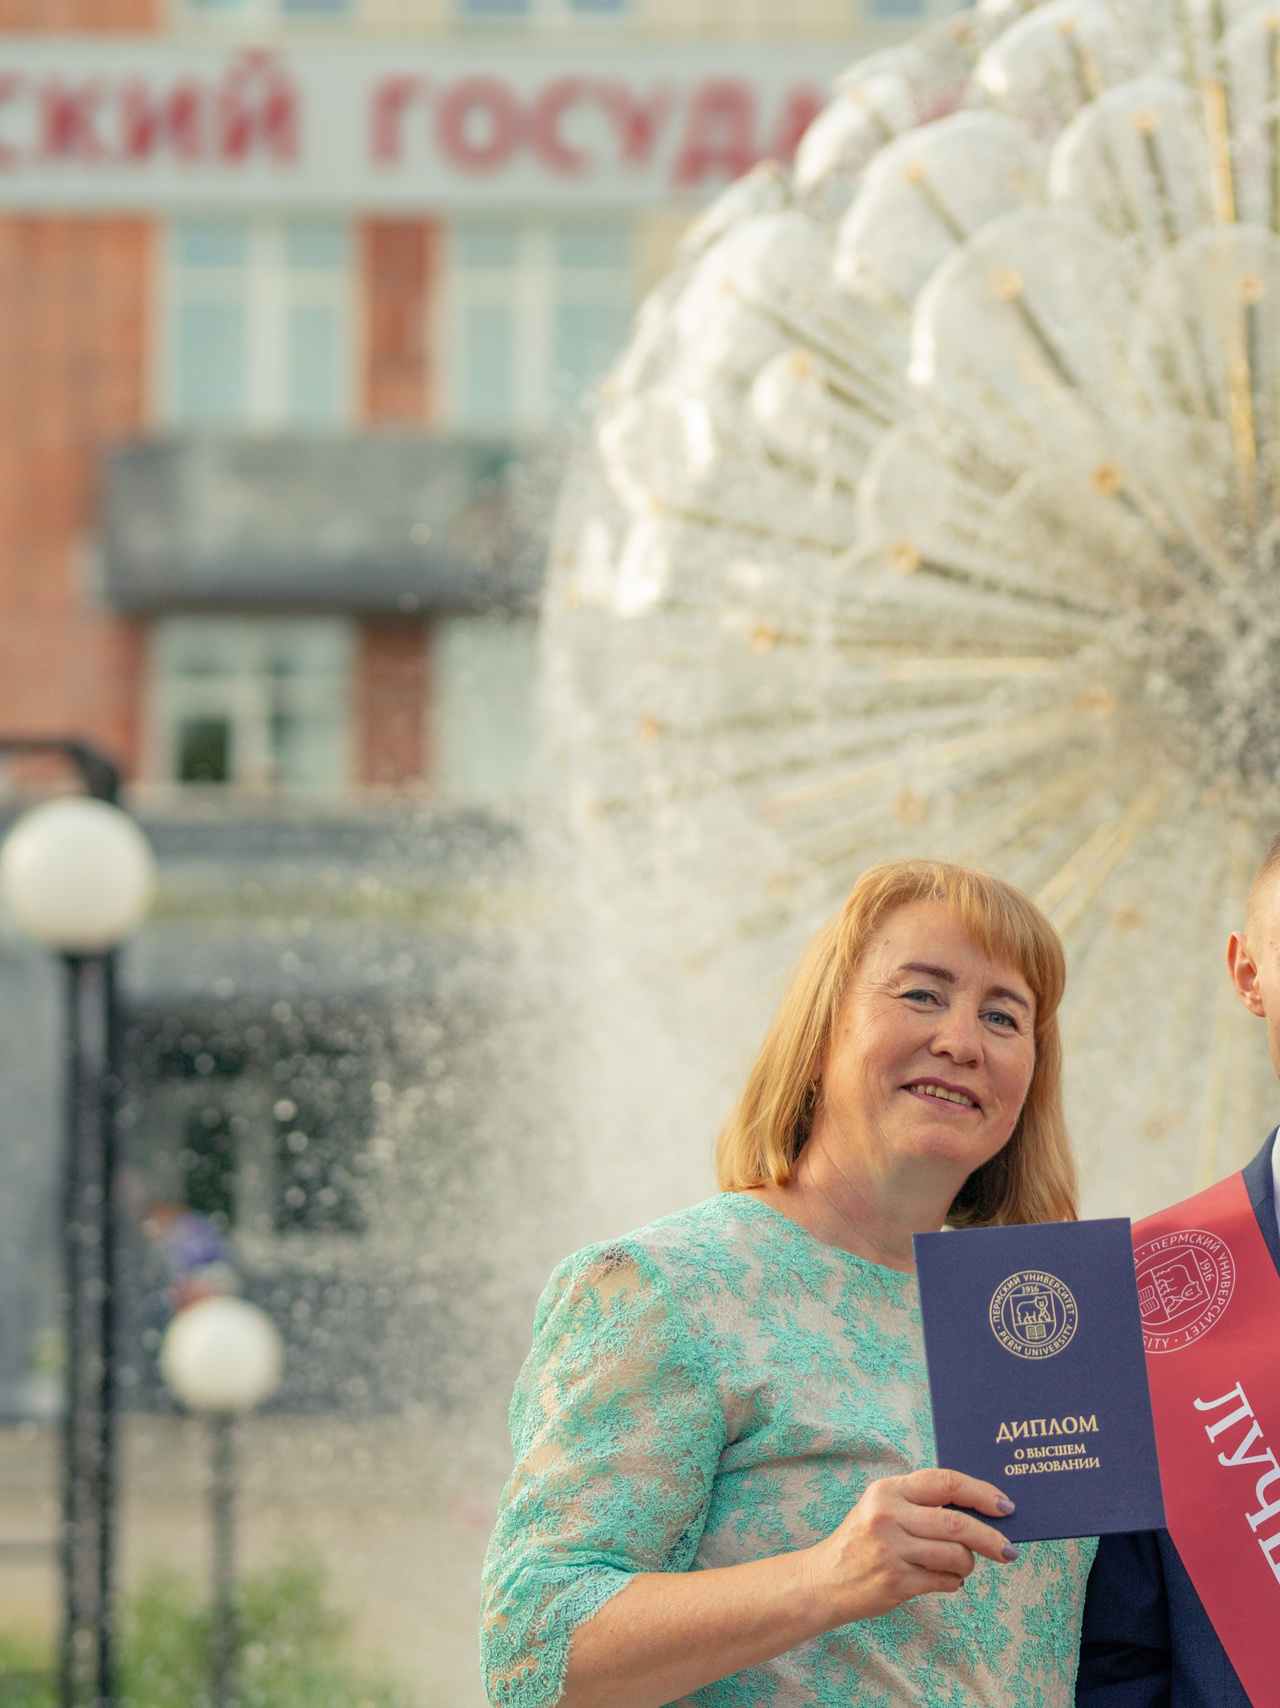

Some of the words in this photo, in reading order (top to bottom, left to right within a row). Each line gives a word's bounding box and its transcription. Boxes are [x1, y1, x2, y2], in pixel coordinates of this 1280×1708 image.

[1150, 1233, 1221, 1254] ПЕРМСКИЙ
[1199, 1258, 1215, 1282] 1916
[992, 1275, 1021, 1323] ПЕРМСКИЙ
[1022, 1273, 1075, 1316] УНИВЕРСИТЕТ
[1021, 1285, 1040, 1294] 1916
[1185, 1252, 1232, 1342] УНИВЕРСИТЕТ
[998, 1330, 1022, 1353] PERM
[1024, 1323, 1073, 1356] UNIVERSITY
[995, 1414, 1100, 1444] ДИПЛОМ
[1014, 1448, 1025, 1460] О
[1026, 1443, 1087, 1459] ВЫСШЕМ
[1004, 1456, 1101, 1476] ОБРАЗОВАНИИ
